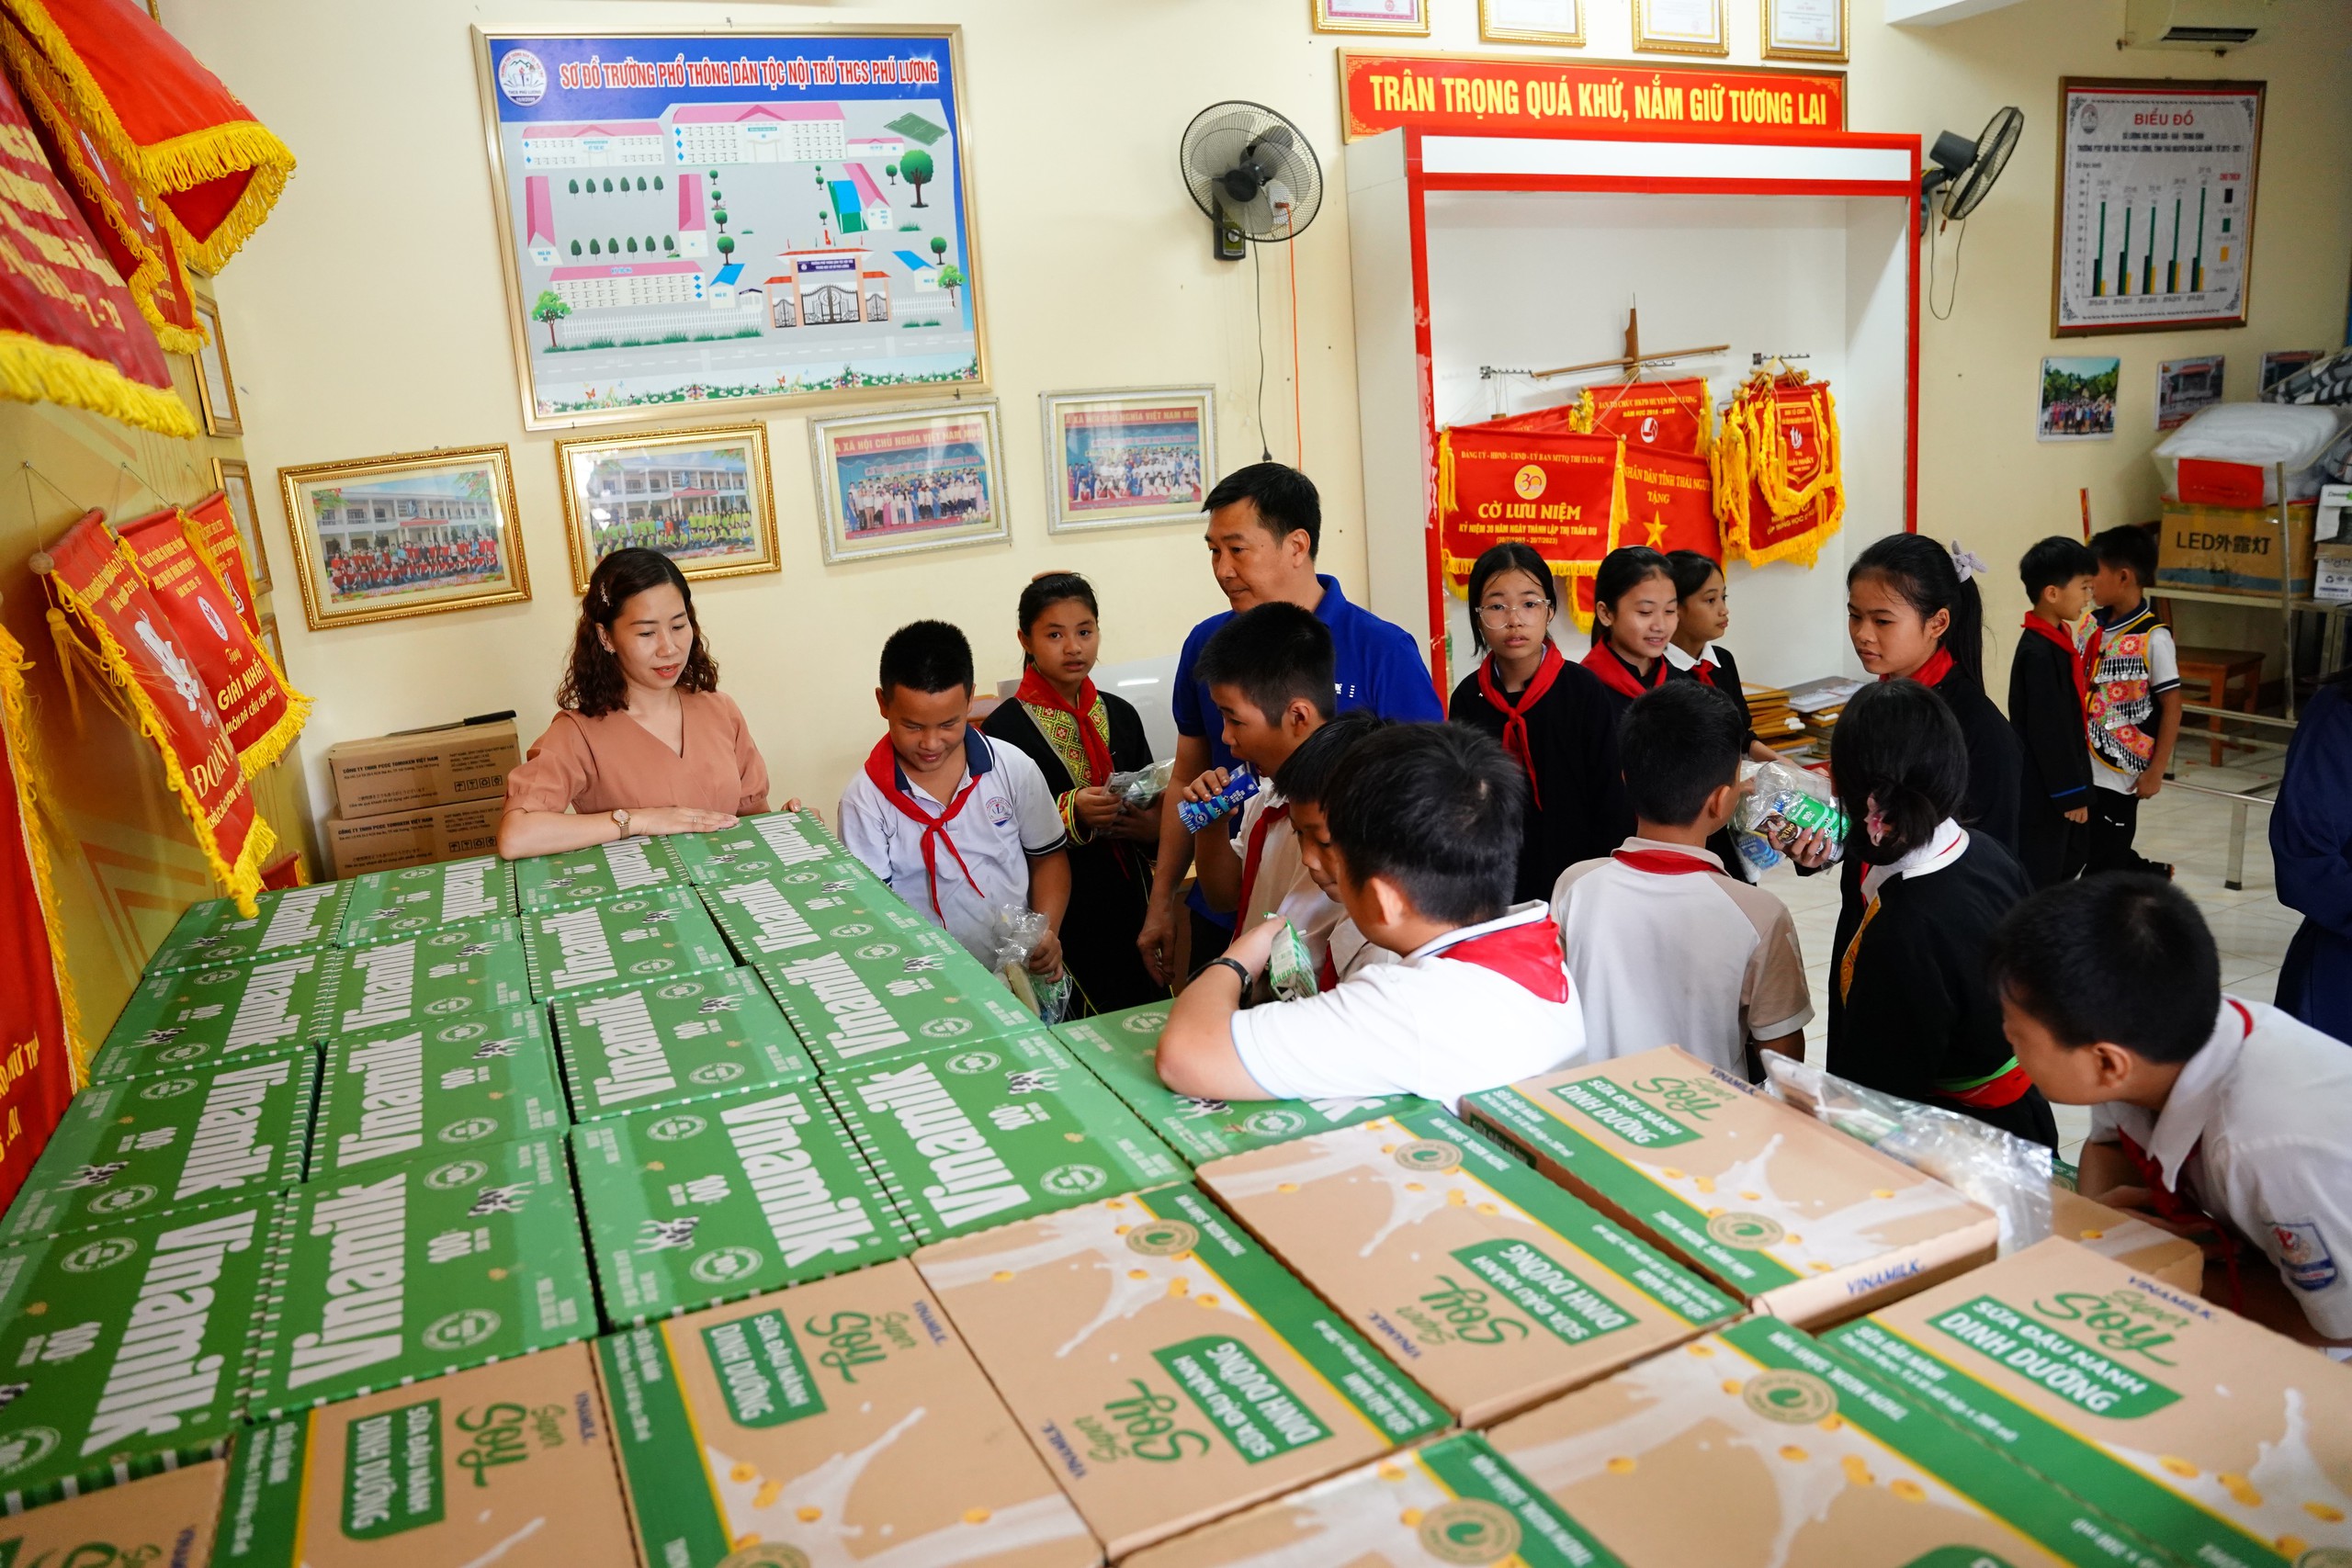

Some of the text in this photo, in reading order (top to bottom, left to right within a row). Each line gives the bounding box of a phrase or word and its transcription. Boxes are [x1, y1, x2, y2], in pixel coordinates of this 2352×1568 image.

[560, 63, 579, 88] SƠ
[582, 55, 601, 87] ĐỒ
[603, 57, 655, 86] TRƯỜNG
[659, 53, 684, 85] PHỔ
[689, 57, 729, 85] THÔNG
[732, 57, 759, 85] DÂN
[761, 57, 786, 89] TỘC
[788, 57, 810, 88] NỘI
[812, 57, 835, 84] TRÚ
[838, 62, 869, 84] THCS
[872, 56, 896, 84] PHÚ
[899, 59, 938, 83] LƯƠNG
[1370, 69, 1826, 125] TRÂN TRỌNG QUÁ KHỨ, NẮM GIỮ TƯƠNG LAI
[857, 435, 874, 451] HỘI
[1478, 500, 1581, 523] CỜ LƯU NIỆM
[1520, 473, 1542, 491] 30
[1510, 524, 1527, 534] NGÀY
[1527, 524, 1546, 534] THÀNH
[218, 654, 267, 711] GIẢI NHẤT
[750, 812, 831, 866] Vinamilk
[257, 883, 337, 953] Vinamilk
[441, 857, 497, 924] Vinamilk
[718, 878, 821, 953] Vinamilk
[540, 906, 618, 990] Vinamilk
[222, 953, 316, 1055] Vinamilk
[341, 939, 415, 1032] Vinamilk
[779, 951, 911, 1060] Vinamilk
[575, 990, 676, 1106] Vinamilk
[173, 1060, 290, 1201] Vinamilk
[336, 1032, 424, 1168] Vinamilk
[1558, 1085, 1659, 1144] DINH DƯỠNG
[1588, 1079, 1682, 1135] SỮA ĐẬU NÀNH
[1633, 1077, 1721, 1121] Soy
[856, 1062, 1032, 1228] Vinamilk
[720, 1092, 875, 1269] Vinamilk
[288, 1172, 406, 1390] Vinamilk
[1499, 1244, 1577, 1295] DƯỠNG
[1847, 1259, 1921, 1295] VINAMILK
[80, 1209, 258, 1458] Vinamilk
[1420, 1275, 1529, 1344] Soy
[1562, 1290, 1626, 1329] DINH
[2034, 1292, 2177, 1367] Soy
[710, 1323, 775, 1422] DINH DƯỠNG
[805, 1312, 888, 1383] Soy
[1205, 1342, 1280, 1403] DƯỠNG
[1939, 1312, 2018, 1355] DINH
[2006, 1347, 2120, 1412] DƯỠNG
[1973, 1300, 2148, 1394] SỮA ĐẬU NÀNH
[456, 1403, 529, 1487] Soy
[1104, 1379, 1210, 1461] Soy
[1256, 1395, 1322, 1445] DINH
